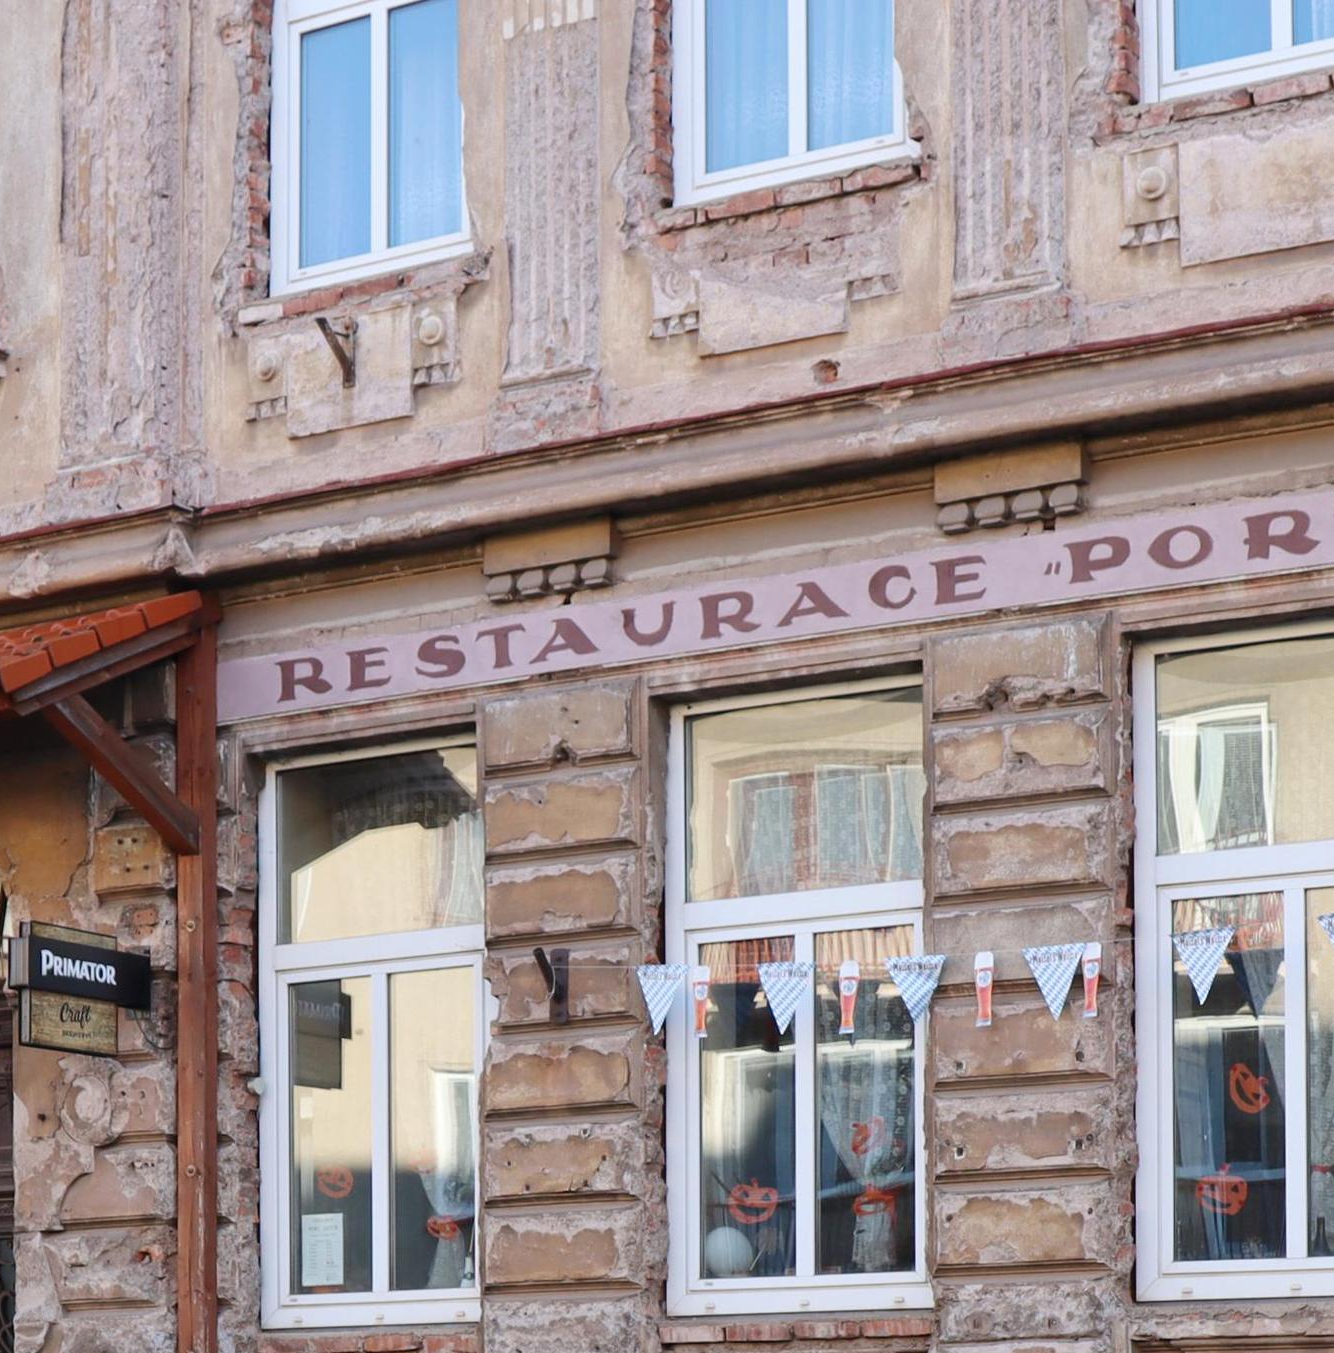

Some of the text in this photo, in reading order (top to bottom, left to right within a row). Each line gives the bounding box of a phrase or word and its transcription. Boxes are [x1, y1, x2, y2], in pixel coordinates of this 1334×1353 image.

[275, 554, 987, 703] RESTAURACE
[40, 949, 118, 987] PRIMATOR
[59, 1001, 92, 1030] Craft
